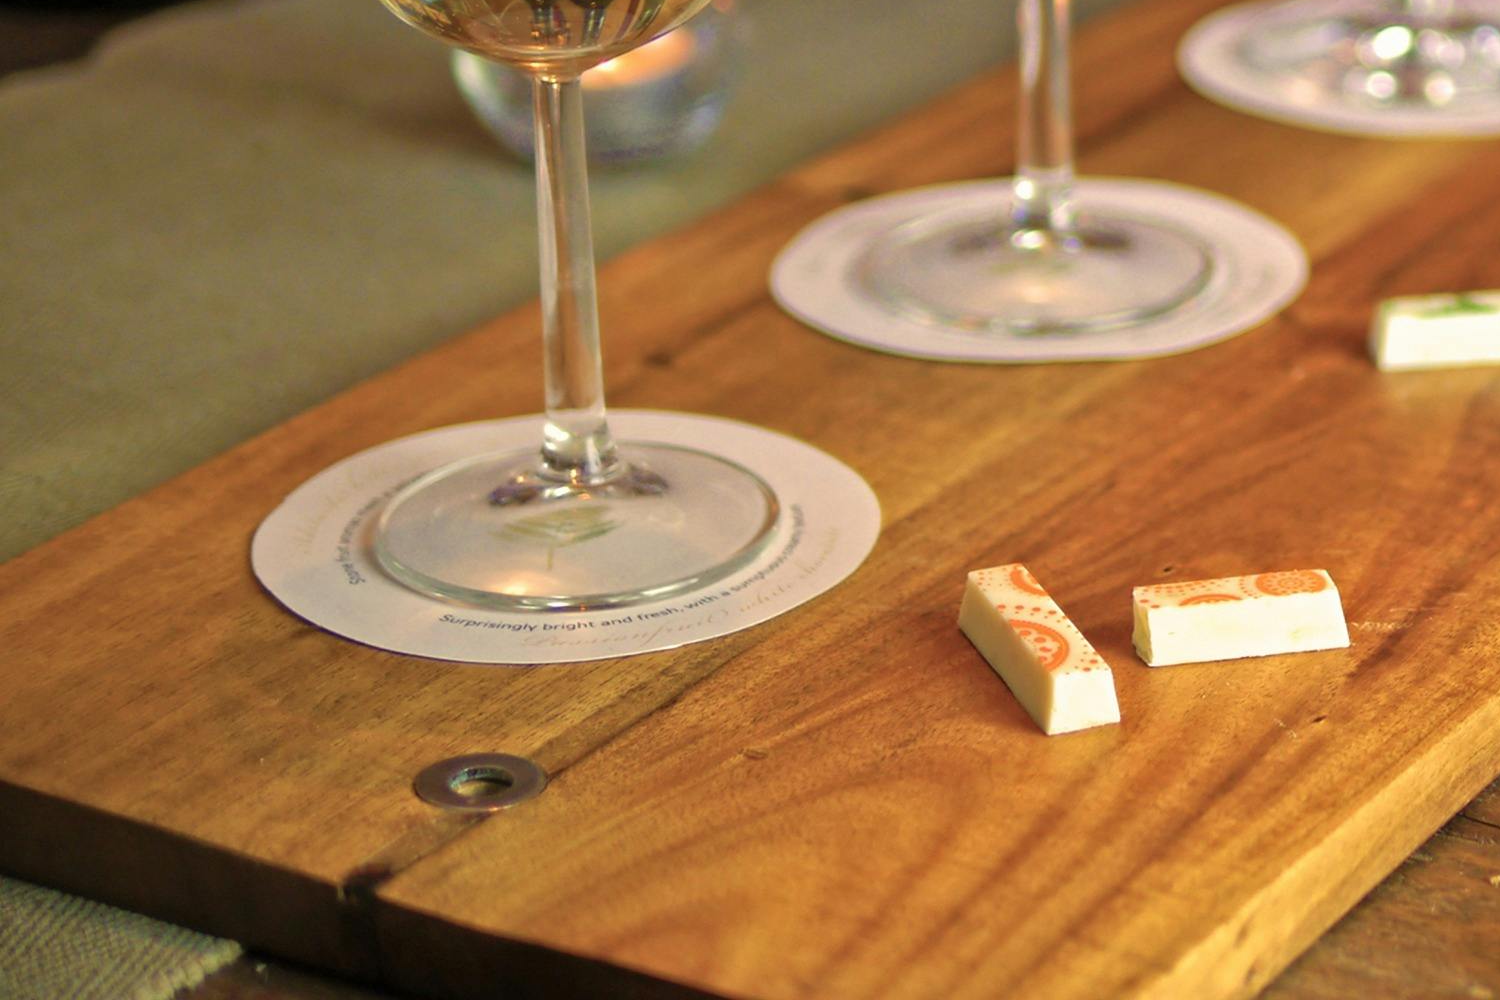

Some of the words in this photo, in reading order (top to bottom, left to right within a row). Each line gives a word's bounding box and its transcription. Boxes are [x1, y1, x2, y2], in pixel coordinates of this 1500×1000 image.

[438, 613, 538, 632] Surprisingly
[543, 622, 595, 632] bright
[601, 615, 633, 627] and
[637, 605, 684, 622] fresh,
[686, 594, 719, 610] with
[721, 590, 731, 598] a
